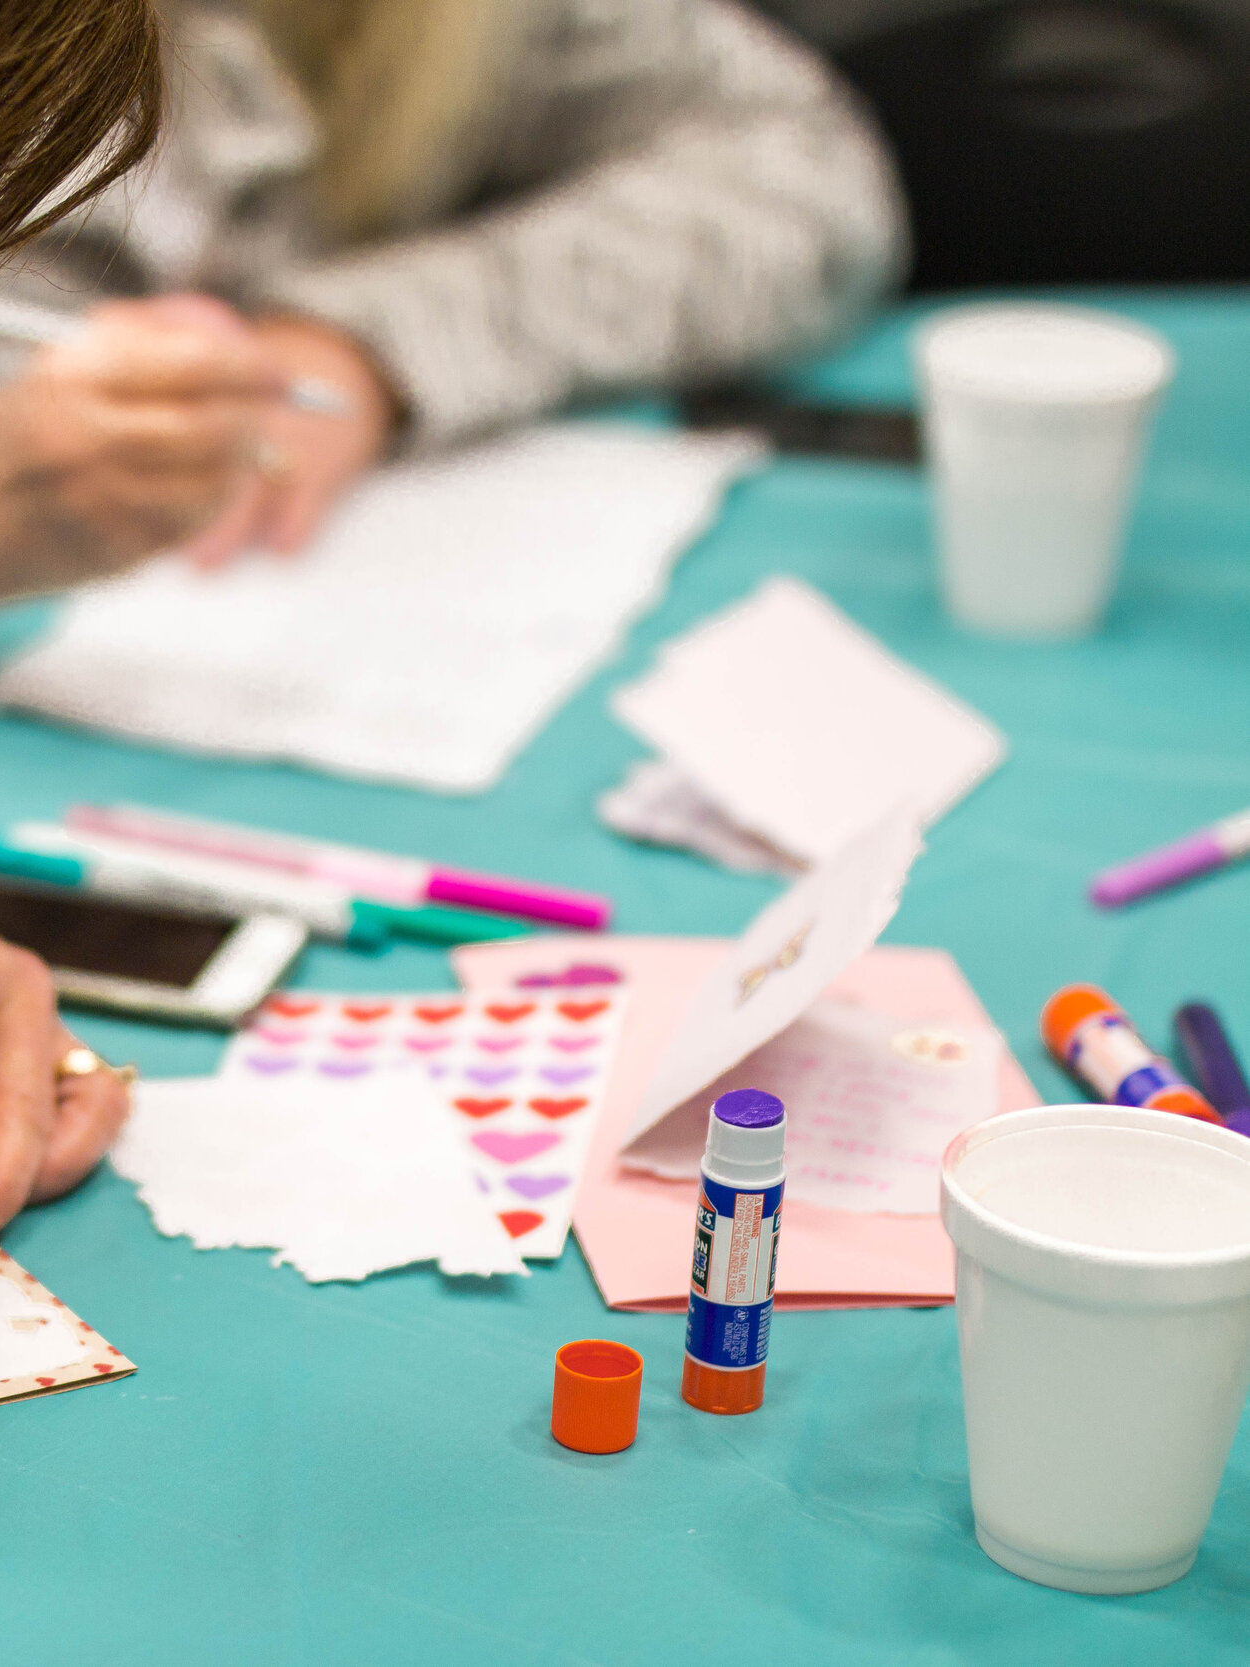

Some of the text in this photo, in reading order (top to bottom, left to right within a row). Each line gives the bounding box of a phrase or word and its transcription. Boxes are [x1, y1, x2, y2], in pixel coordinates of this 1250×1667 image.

[737, 1196, 745, 1208] NOT
[743, 1196, 754, 1223] CHOKING
[736, 1209, 744, 1221] FOR
[732, 1222, 743, 1252] CHILDREN
[731, 1253, 740, 1273] UNDER
[737, 1274, 746, 1293] PARTS
[738, 1322, 750, 1356] CONFORMS
